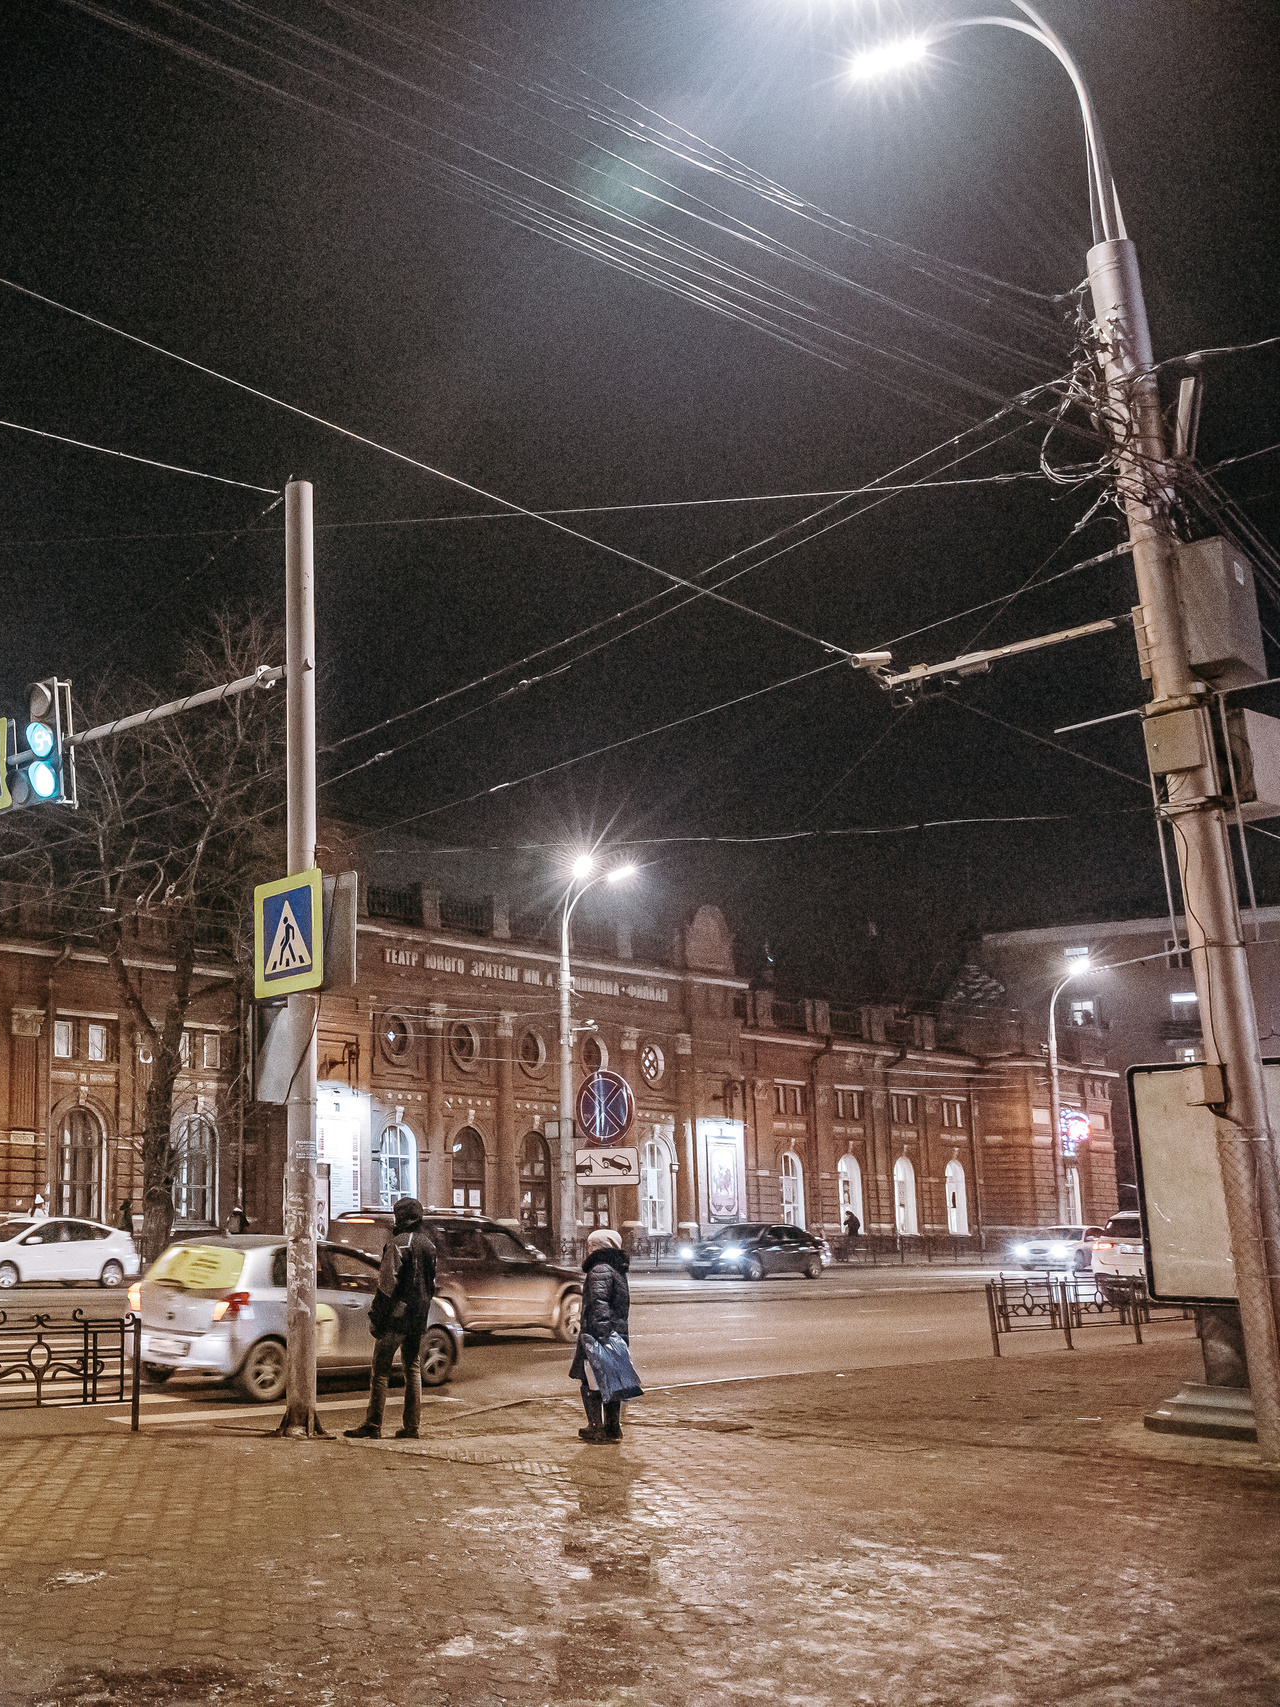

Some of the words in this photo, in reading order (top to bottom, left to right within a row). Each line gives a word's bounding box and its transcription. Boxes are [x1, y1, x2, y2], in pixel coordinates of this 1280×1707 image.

[385, 948, 418, 967] ТЕАТР
[424, 953, 464, 975] ЮНОГО
[470, 960, 519, 982] ЗРИТЕЛЯ
[522, 968, 543, 986] ИМ.
[626, 984, 668, 1003] ФИЛИАЛ
